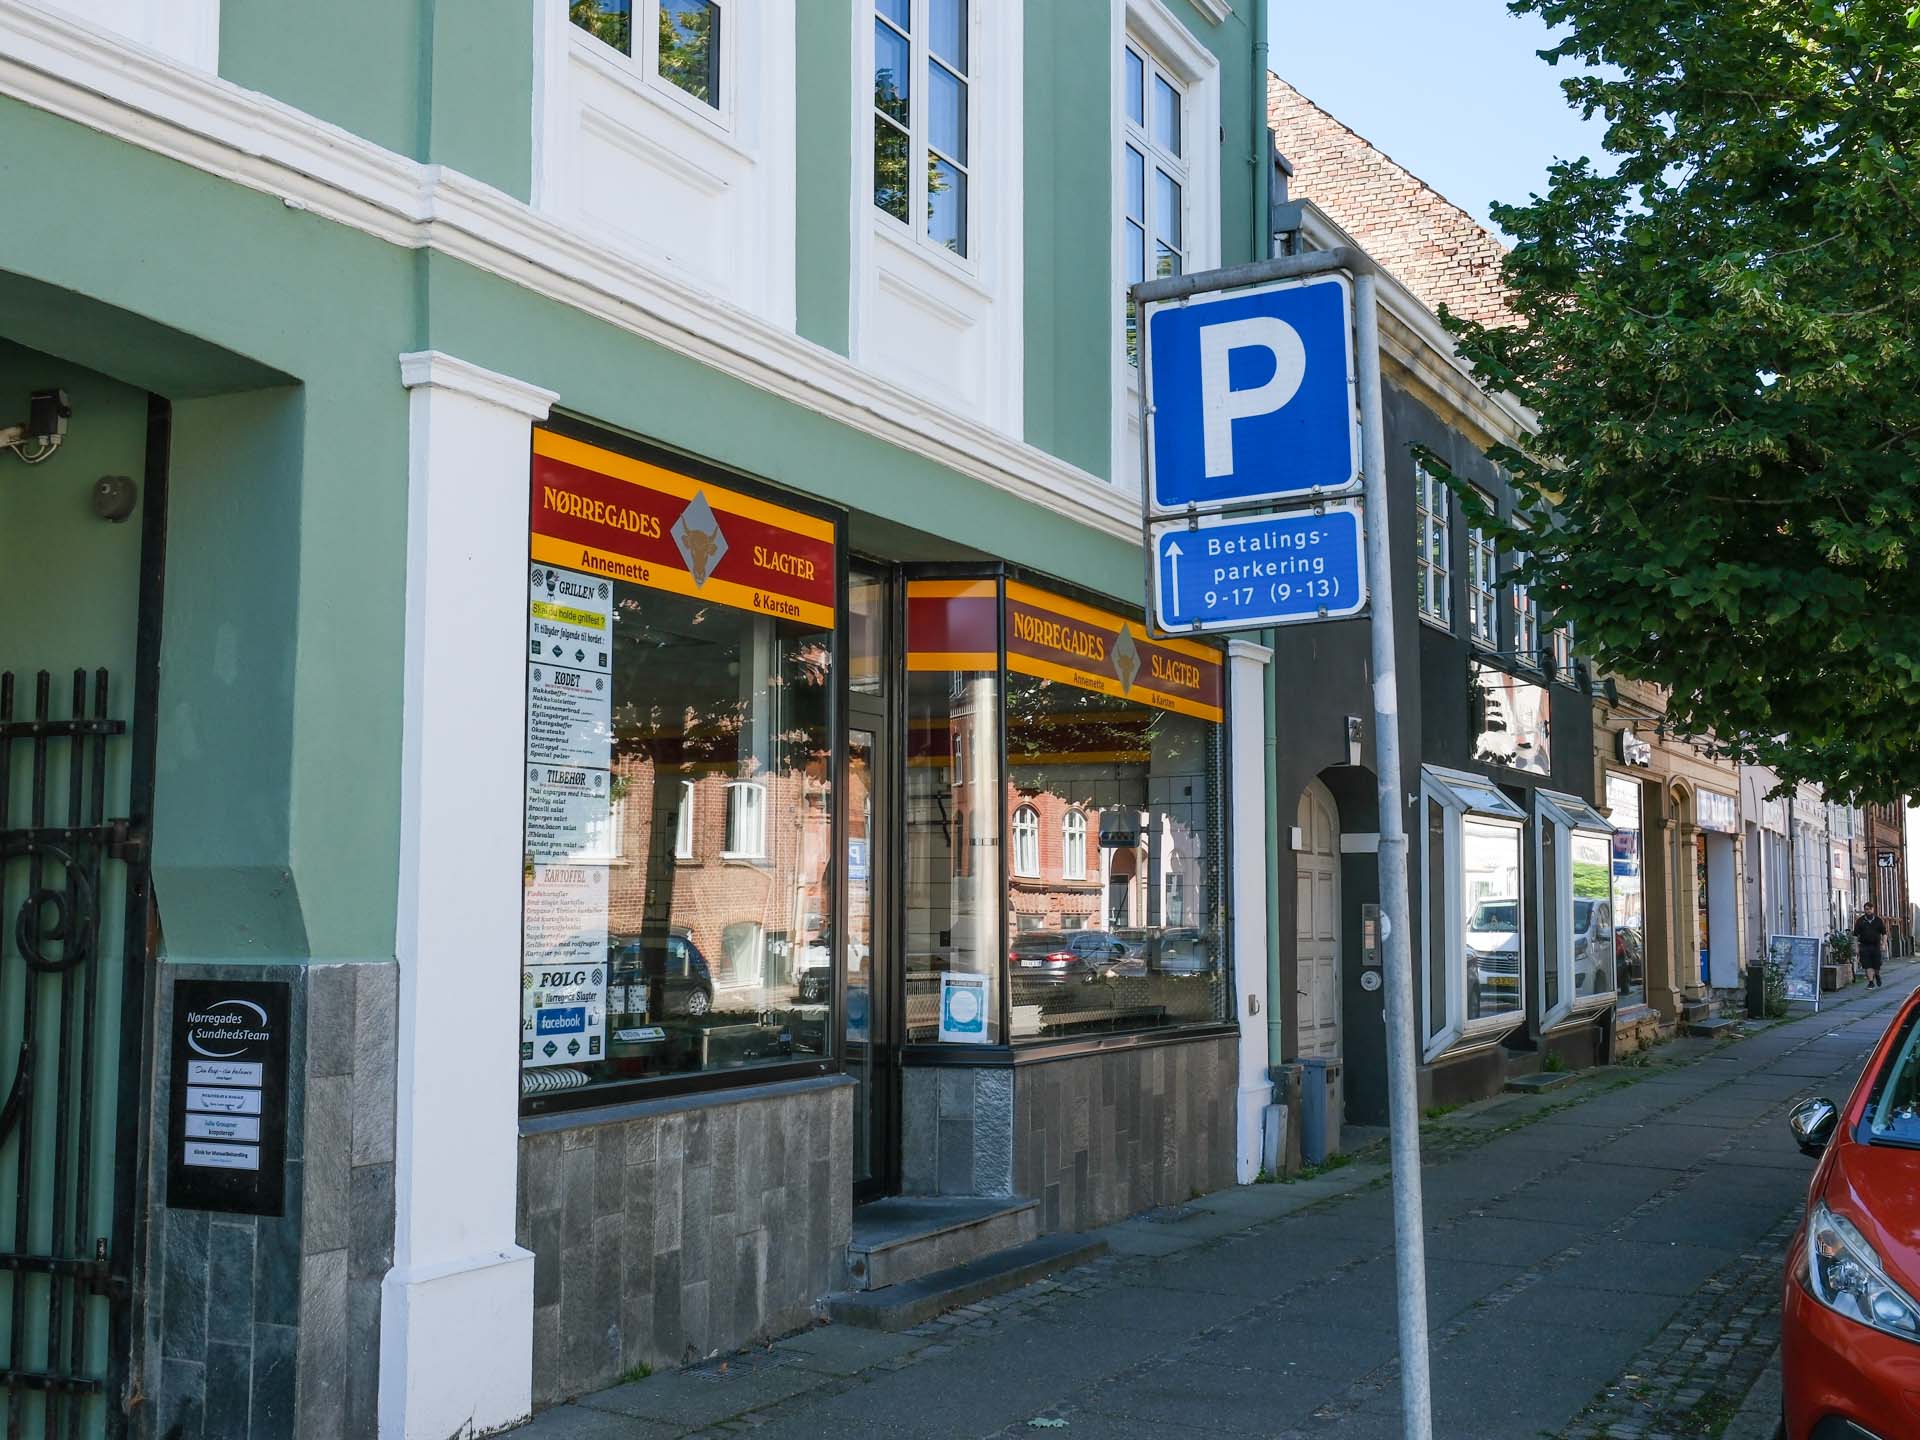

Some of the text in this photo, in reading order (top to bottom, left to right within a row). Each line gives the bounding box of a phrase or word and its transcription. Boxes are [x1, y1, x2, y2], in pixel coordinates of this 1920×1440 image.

[1199, 317, 1306, 479] P
[543, 486, 815, 581] NØRREGADES SLAGTER
[1208, 531, 1329, 555] Betalings-
[1214, 556, 1325, 585] parkering
[559, 580, 595, 600] GRILLEN
[581, 549, 801, 617] Annemette & Karsten
[1203, 576, 1340, 609] 9-17 (9-13)
[1013, 612, 1200, 689] NØRREGADES SLAGTER
[554, 671, 581, 687] KØDET
[1074, 672, 1105, 691] Annemette
[1158, 694, 1176, 709] Karsten
[547, 769, 586, 786] TILBEHØR
[540, 971, 586, 988] FØLG
[187, 1012, 243, 1026] Nørregades
[541, 1015, 582, 1029] facebook
[195, 1028, 270, 1042] SundhedsTeam
